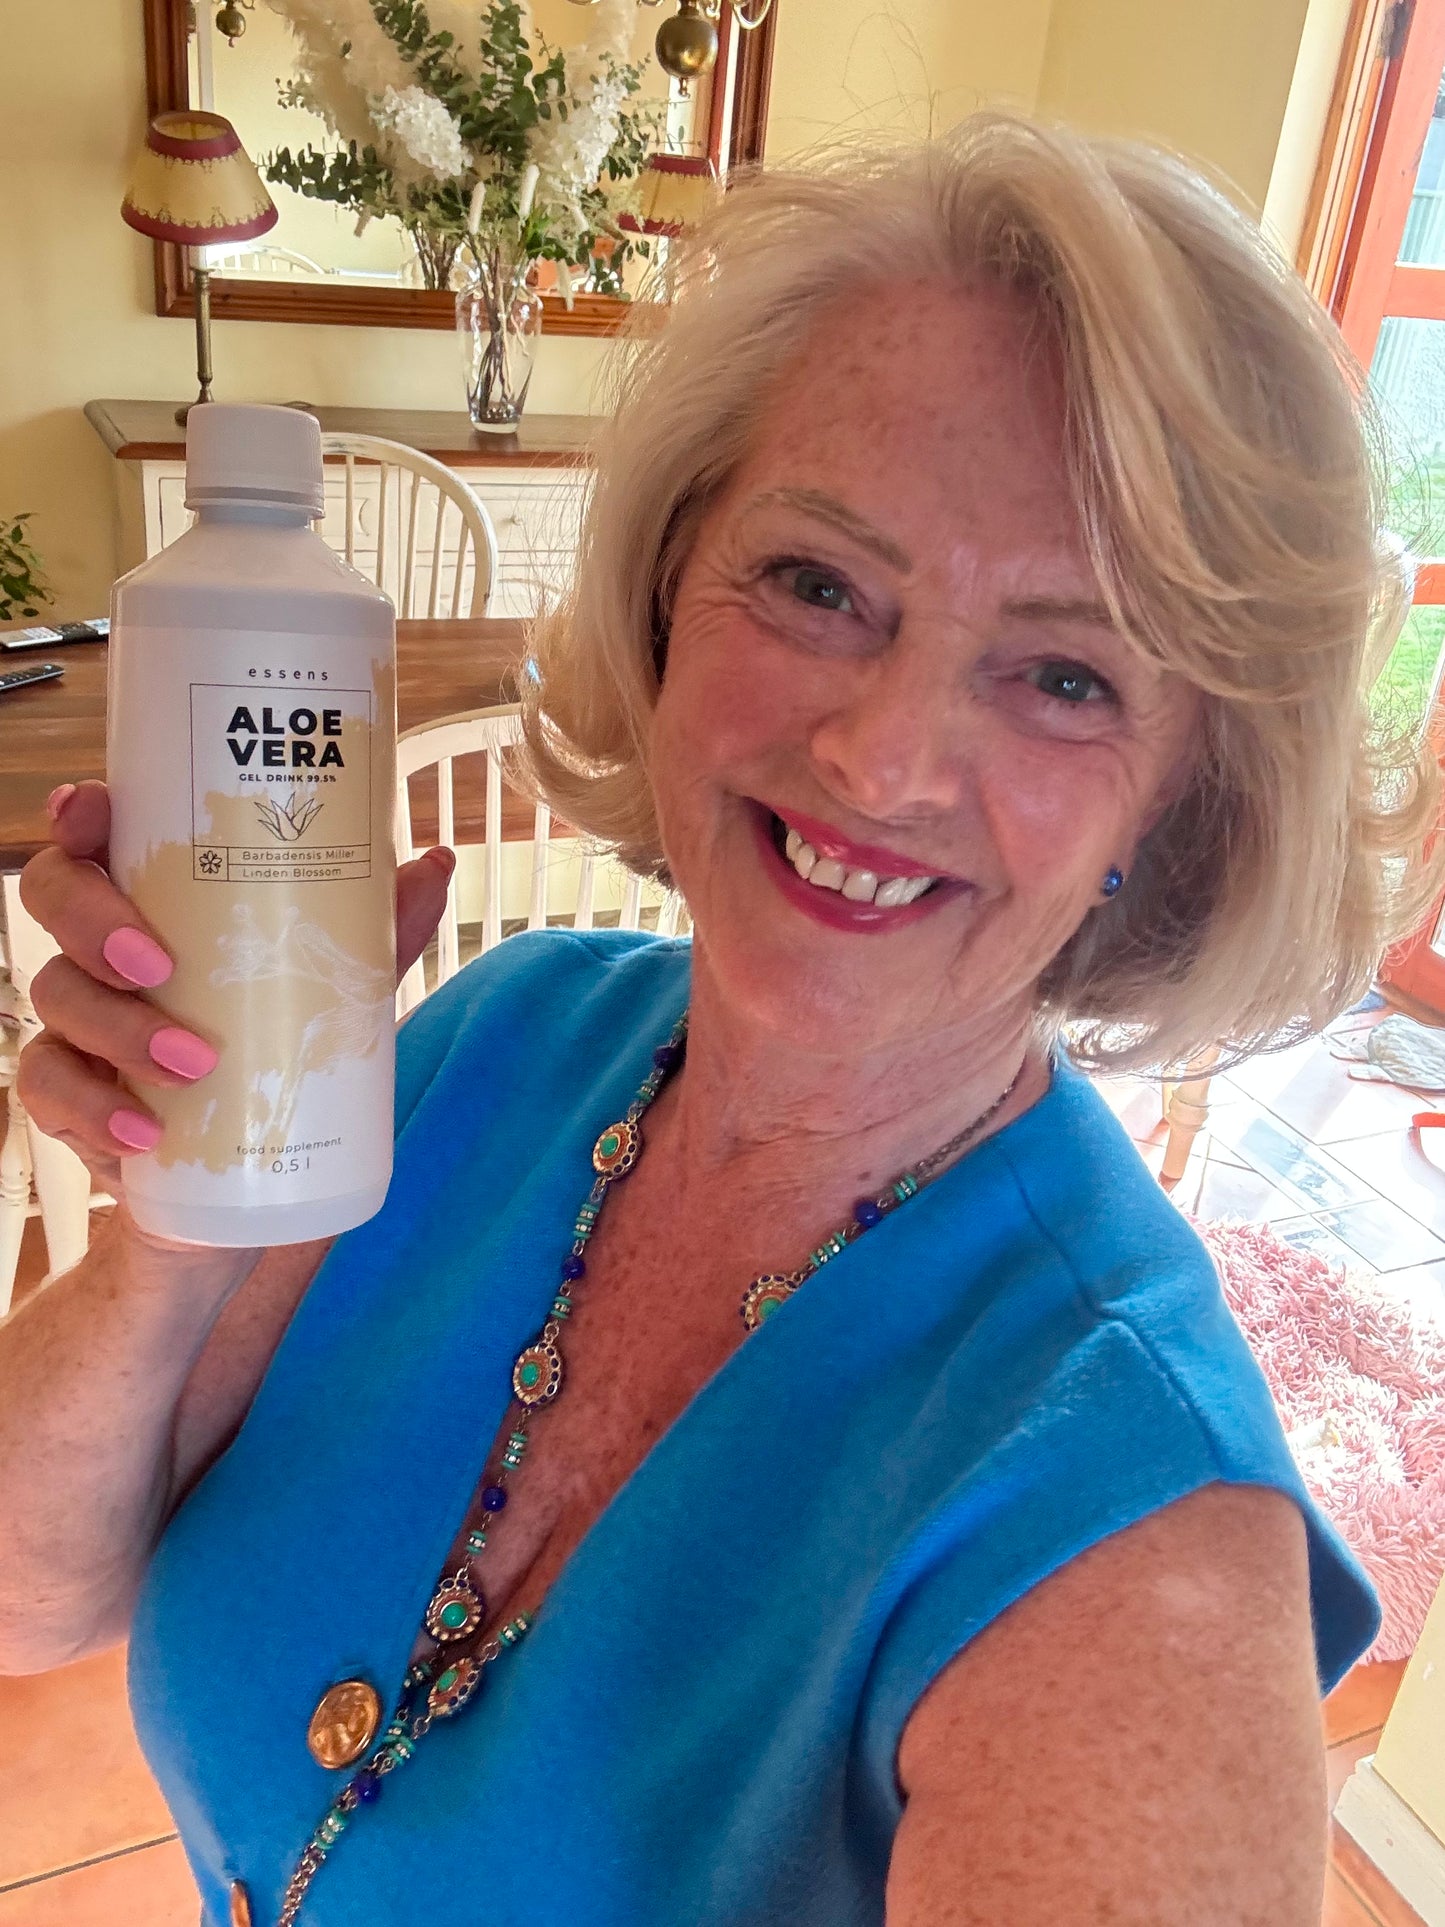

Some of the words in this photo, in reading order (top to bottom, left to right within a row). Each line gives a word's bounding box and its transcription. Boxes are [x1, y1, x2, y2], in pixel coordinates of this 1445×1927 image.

[248, 667, 329, 681] essens
[225, 706, 343, 736] ALOE
[226, 738, 345, 768] VERA
[238, 773, 262, 782] GEL
[266, 773, 304, 783] DRINK
[306, 774, 337, 783] 99.5%
[242, 850, 322, 861] Barbadensis
[325, 849, 355, 860] Miller
[242, 867, 288, 878] Linden
[293, 866, 342, 878] Blossom
[236, 1145, 265, 1155] food
[270, 1137, 342, 1154] supplement
[271, 1158, 300, 1174] 0,5
